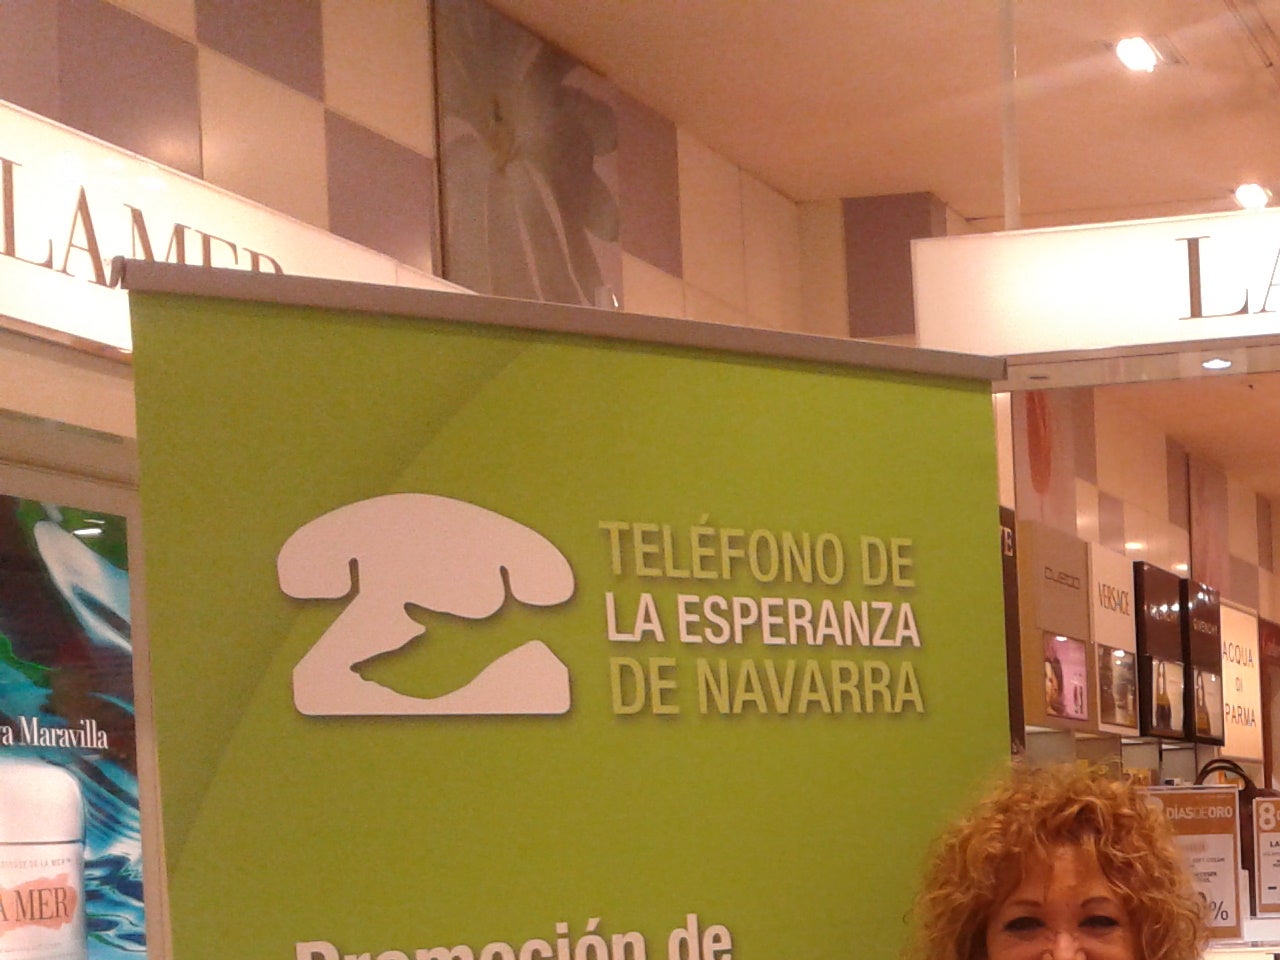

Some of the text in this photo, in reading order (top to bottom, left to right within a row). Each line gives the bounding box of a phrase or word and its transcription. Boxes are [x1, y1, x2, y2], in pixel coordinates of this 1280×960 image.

[0, 157, 113, 288] LA
[599, 513, 915, 588] TELÉFONO DE
[1098, 582, 1131, 616] VERSACE
[606, 592, 921, 648] LA ESPERANZA
[1222, 640, 1255, 668] ACQUA
[609, 656, 924, 714] DE NAVARRA
[1225, 702, 1256, 727] PARMA
[18, 715, 109, 749] Maravilla
[1259, 802, 1276, 831] 8
[14, 887, 69, 922] MER
